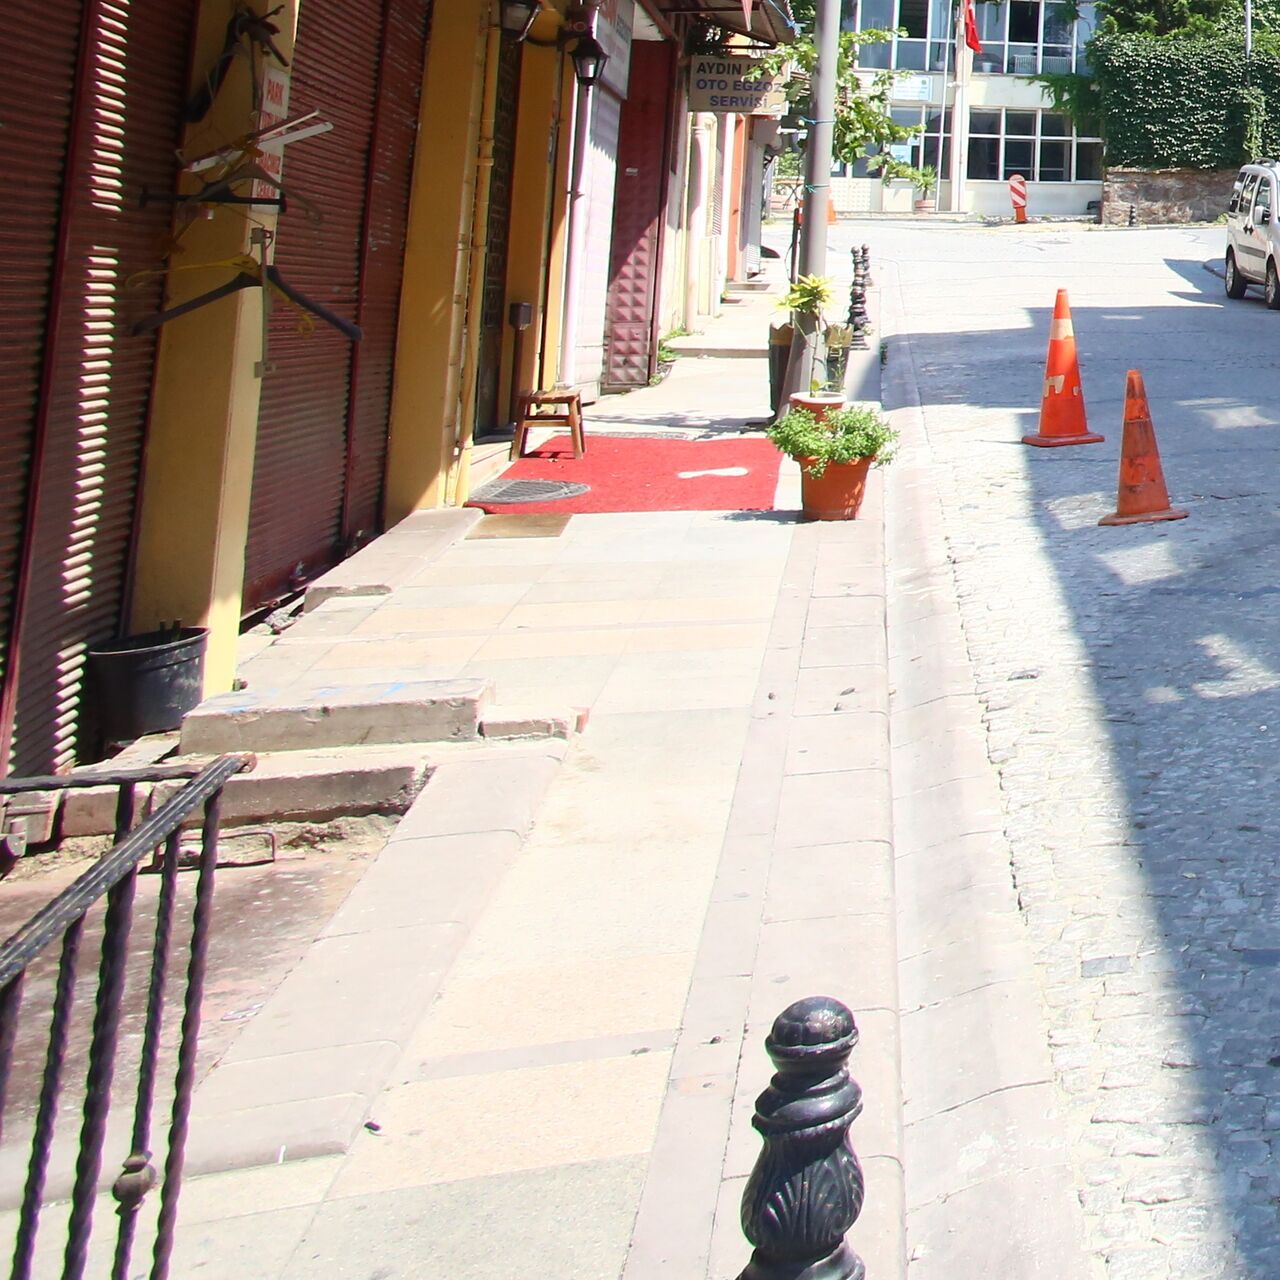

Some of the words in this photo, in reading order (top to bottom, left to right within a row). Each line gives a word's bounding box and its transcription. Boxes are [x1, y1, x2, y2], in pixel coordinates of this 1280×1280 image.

[697, 62, 741, 75] AYDIN
[697, 79, 728, 91] OTO
[733, 80, 783, 93] EGZOZ
[710, 94, 767, 108] SERVİSİ
